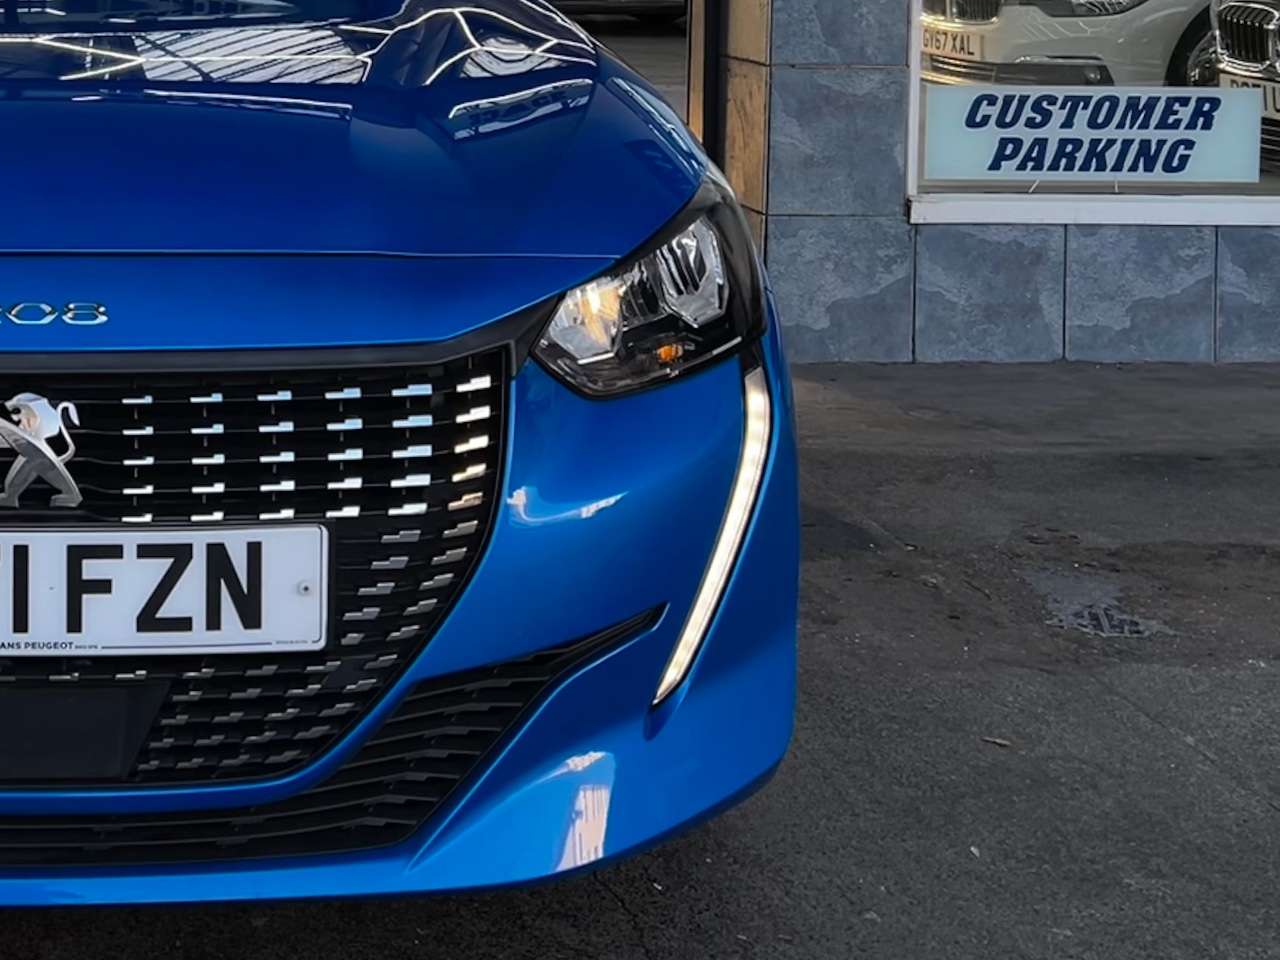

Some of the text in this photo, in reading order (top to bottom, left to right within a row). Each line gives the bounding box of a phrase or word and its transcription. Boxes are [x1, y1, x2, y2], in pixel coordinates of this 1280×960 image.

[950, 31, 975, 56] XAL
[965, 94, 1222, 132] CUSTOMER
[986, 137, 1197, 174] PARKING
[65, 541, 263, 634] FZN
[24, 641, 74, 650] PEUGEOT
